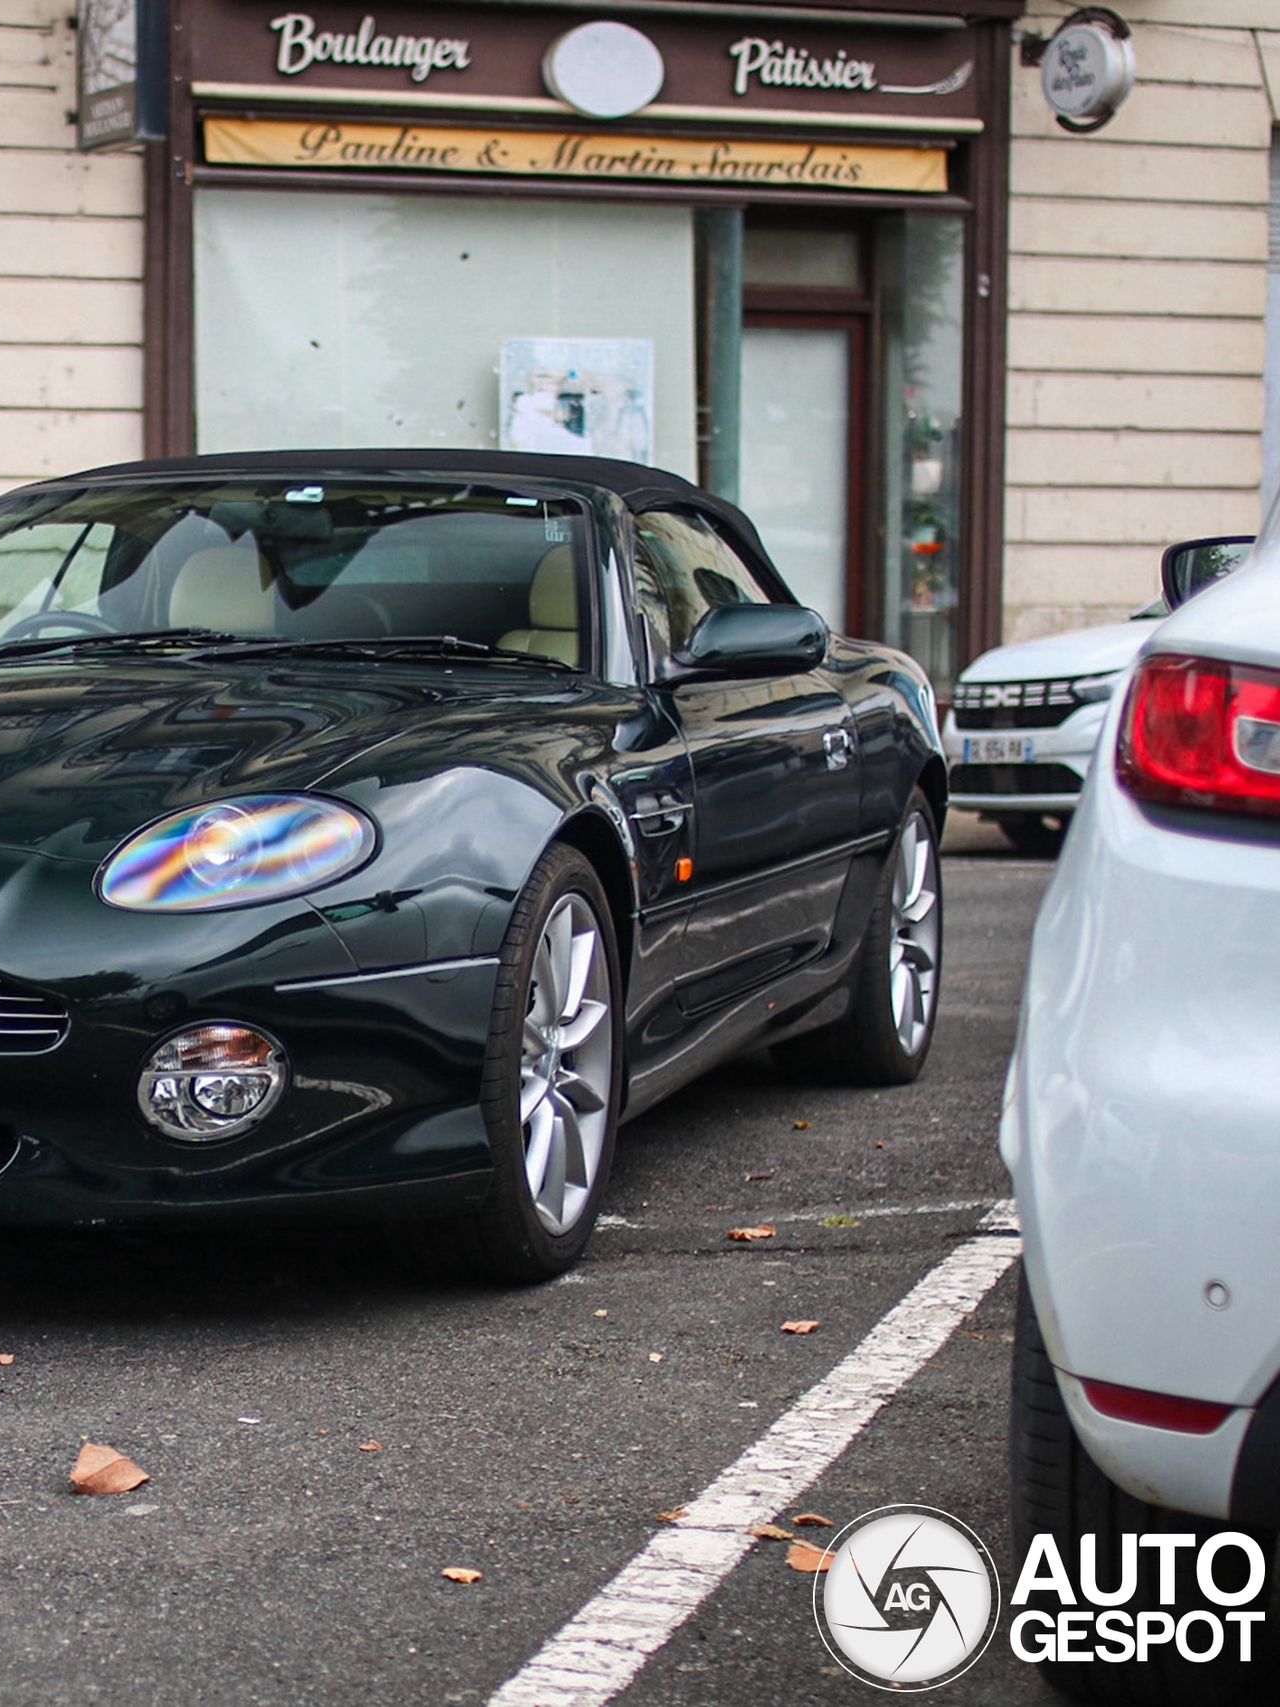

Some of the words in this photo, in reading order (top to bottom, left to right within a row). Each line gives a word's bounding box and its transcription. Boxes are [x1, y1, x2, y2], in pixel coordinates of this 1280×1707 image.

[270, 13, 472, 82] Boulanger
[729, 37, 877, 95] Pâtissier
[295, 124, 460, 166] Pauline
[477, 138, 509, 168] &
[529, 134, 675, 176] Martin
[692, 142, 865, 182] Sourdais
